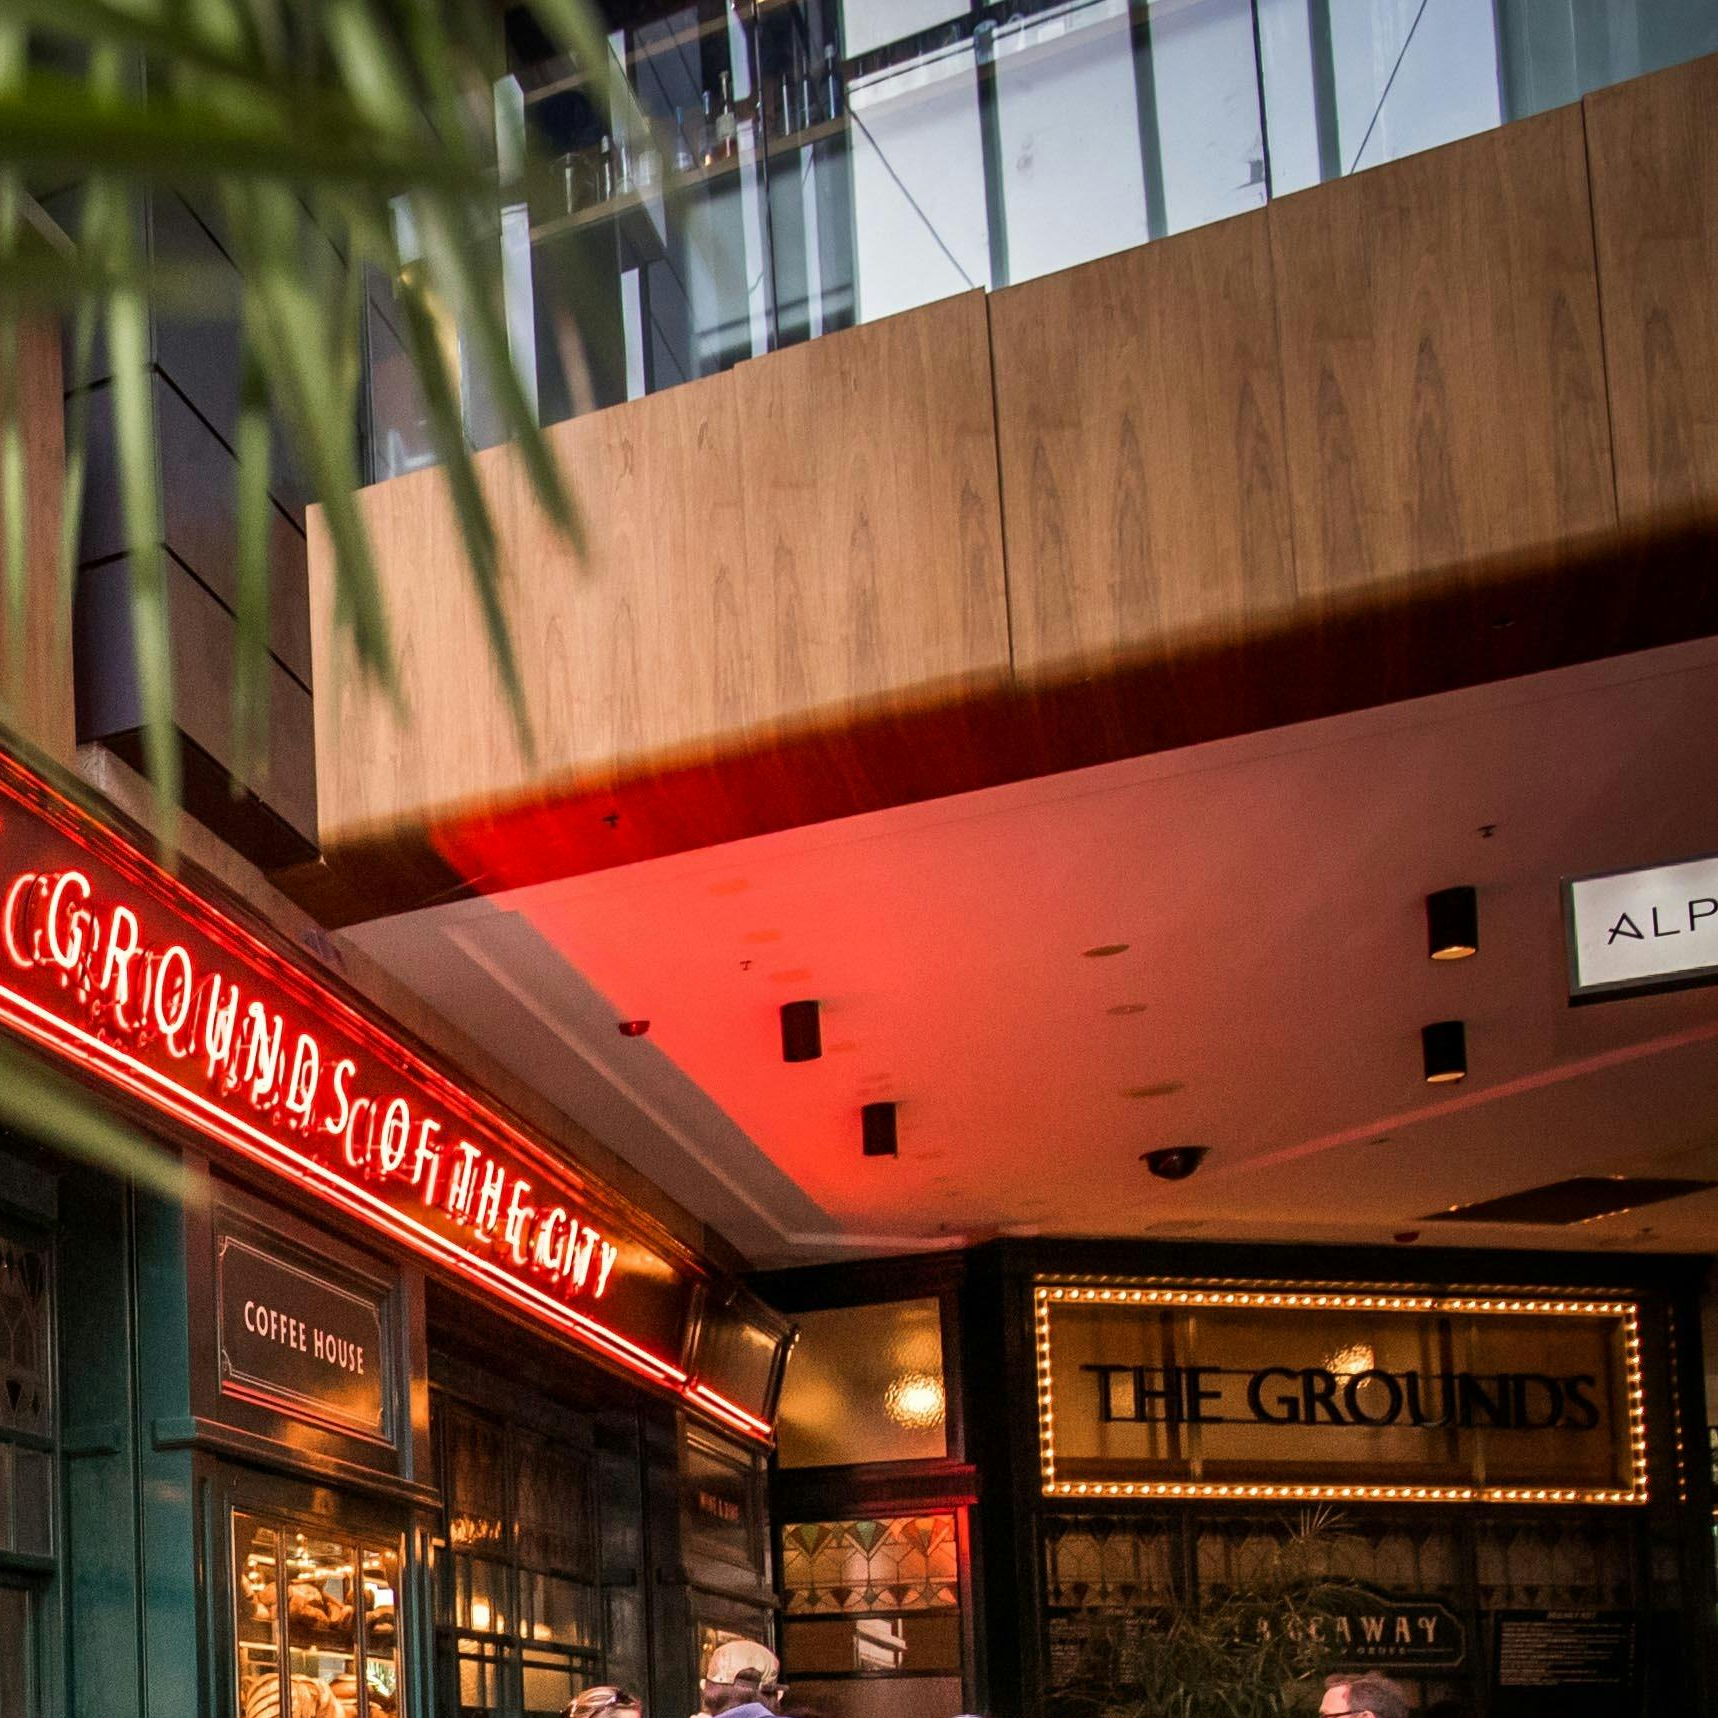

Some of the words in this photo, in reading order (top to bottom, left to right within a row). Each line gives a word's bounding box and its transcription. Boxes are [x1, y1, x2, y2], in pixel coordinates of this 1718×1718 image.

[1606, 897, 1718, 945] ALP
[47, 872, 357, 1135] GROUNDS
[379, 1097, 442, 1184] OF
[459, 1140, 533, 1245] THE
[541, 1207, 619, 1299] CITY
[243, 1300, 307, 1352] COFFEE
[313, 1328, 365, 1375] HOUSE
[1080, 1363, 1222, 1423] THE
[1247, 1366, 1600, 1430] GROUNDS
[1227, 1615, 1438, 1643] AEAWAY
